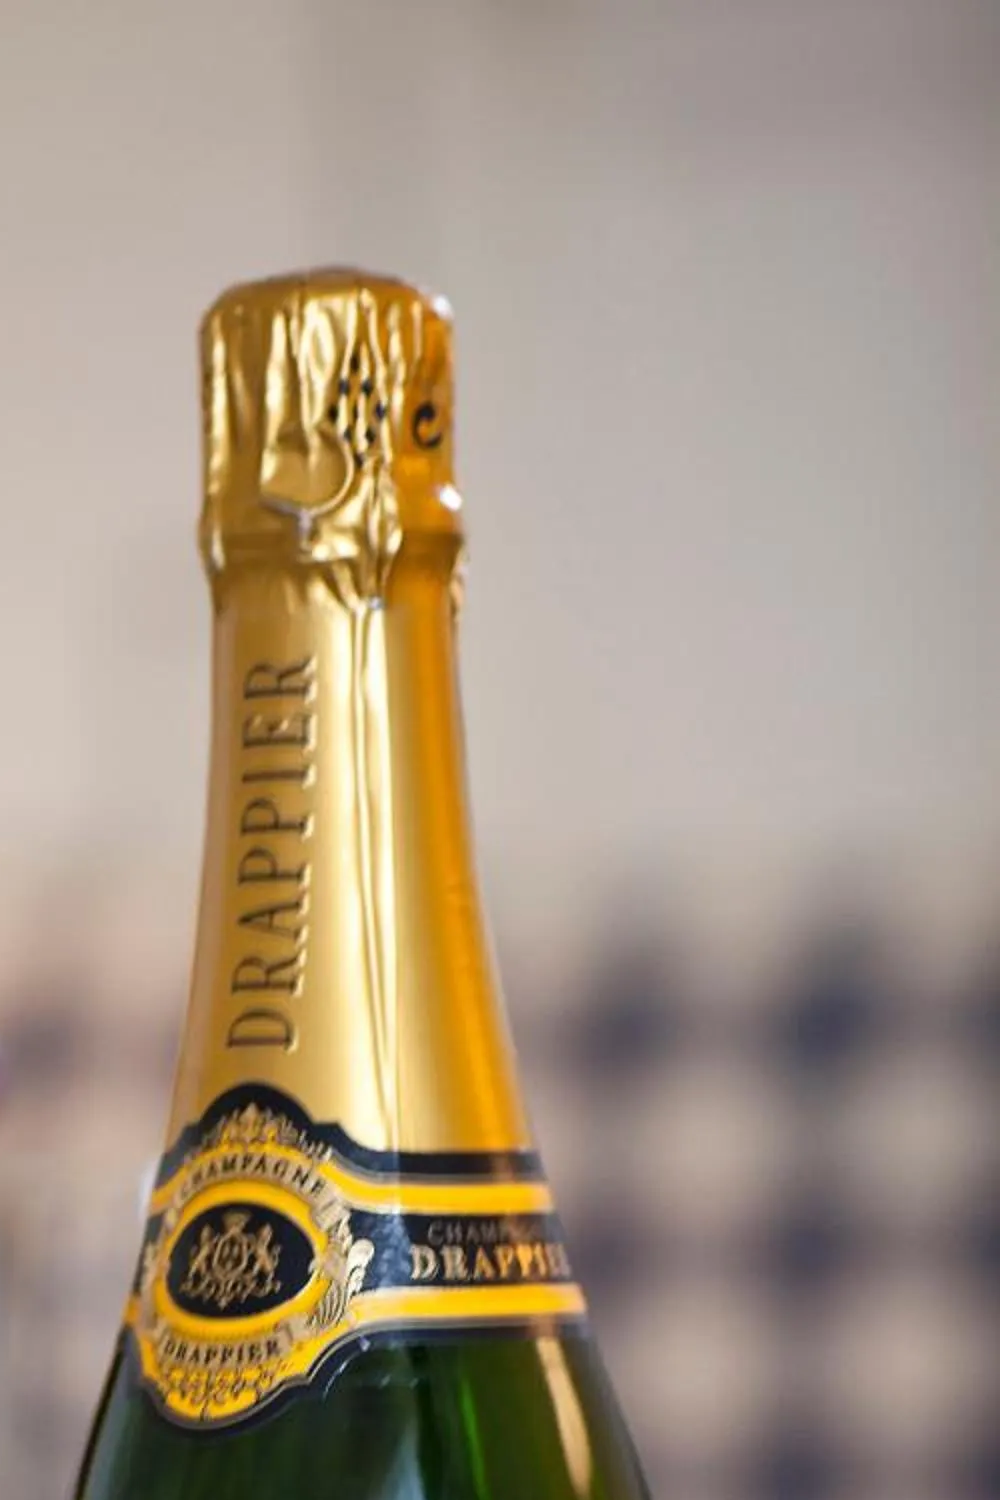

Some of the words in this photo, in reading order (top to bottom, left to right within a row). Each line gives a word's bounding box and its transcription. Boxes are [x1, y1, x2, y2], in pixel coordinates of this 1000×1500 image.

[226, 656, 318, 1054] DRAPPIER
[180, 1153, 326, 1199] CHAMPAGNE
[163, 1338, 280, 1365] DRAPPIER
